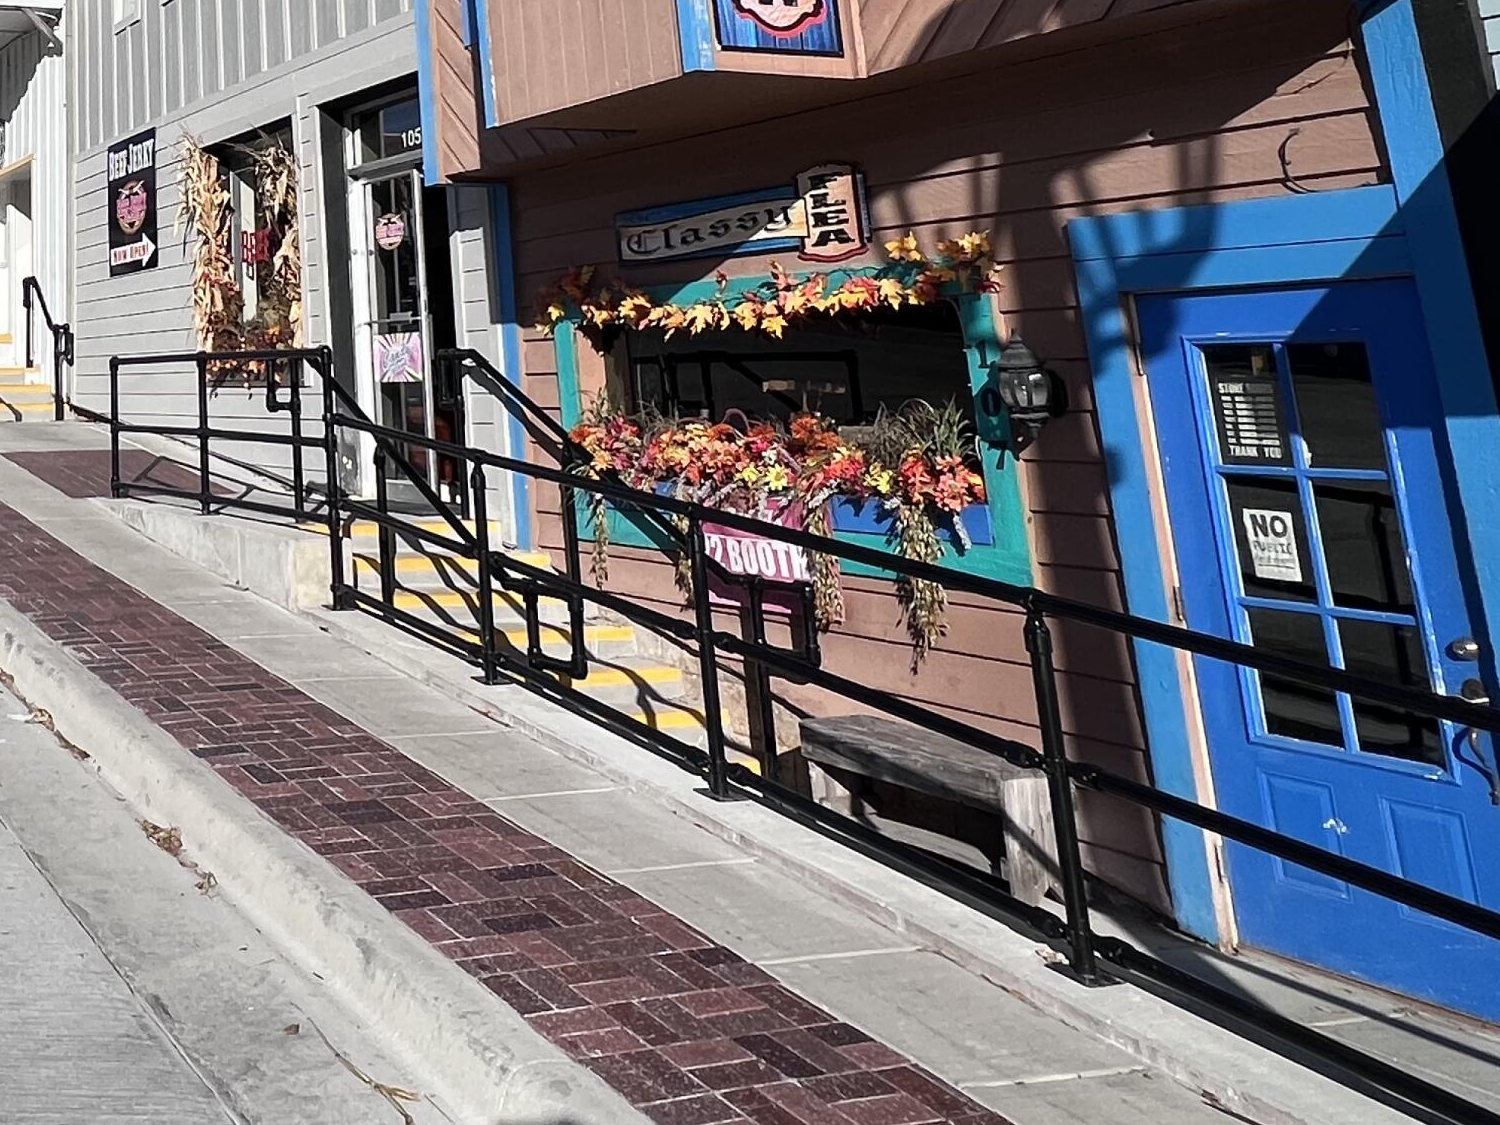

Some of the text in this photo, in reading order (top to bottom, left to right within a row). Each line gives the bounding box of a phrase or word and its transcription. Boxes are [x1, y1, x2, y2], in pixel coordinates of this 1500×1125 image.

[401, 126, 422, 148] 105
[109, 138, 155, 182] BEEF JERKY
[807, 172, 855, 248] FLEA
[626, 204, 796, 257] Classy
[1228, 445, 1282, 459] THANK YOU
[1249, 513, 1288, 538] NO
